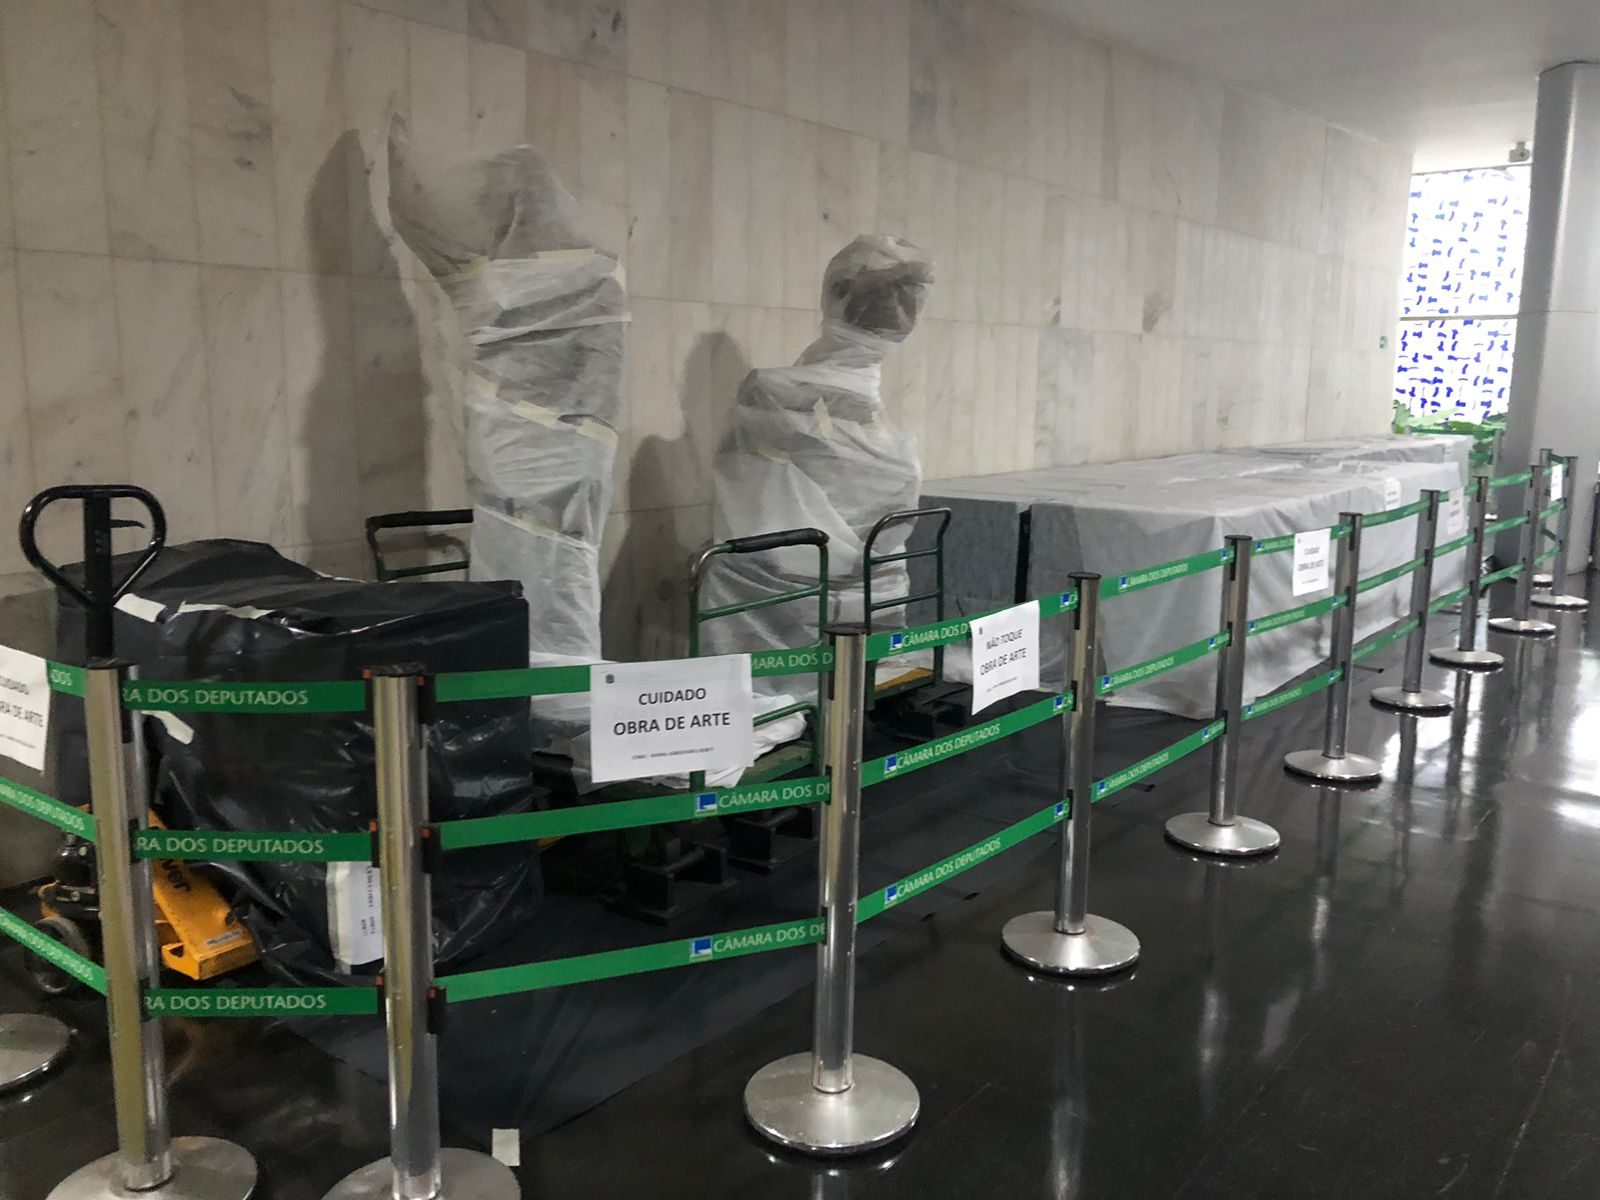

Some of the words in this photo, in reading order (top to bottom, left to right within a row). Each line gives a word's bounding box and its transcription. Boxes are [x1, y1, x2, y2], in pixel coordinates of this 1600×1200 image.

[940, 624, 960, 640] DOS
[788, 653, 818, 667] DOS
[980, 659, 997, 676] OBRA
[997, 654, 1008, 667] DE
[1009, 647, 1027, 662] ARTE
[147, 688, 190, 704] DOS
[194, 689, 309, 705] DEPUTADOS
[638, 687, 707, 706] CUIDADO
[613, 719, 661, 736] OBRA
[664, 716, 686, 731] DE
[689, 712, 731, 729] ARTE
[719, 788, 779, 808] CÂMARA
[782, 784, 812, 800] DOS
[166, 837, 207, 853] DOS
[212, 838, 325, 854] DEPUTADOS
[713, 931, 773, 953] CÂMARA
[776, 926, 806, 942] DOS
[170, 995, 211, 1010] DOS
[216, 994, 327, 1010] DEPUTADOS
